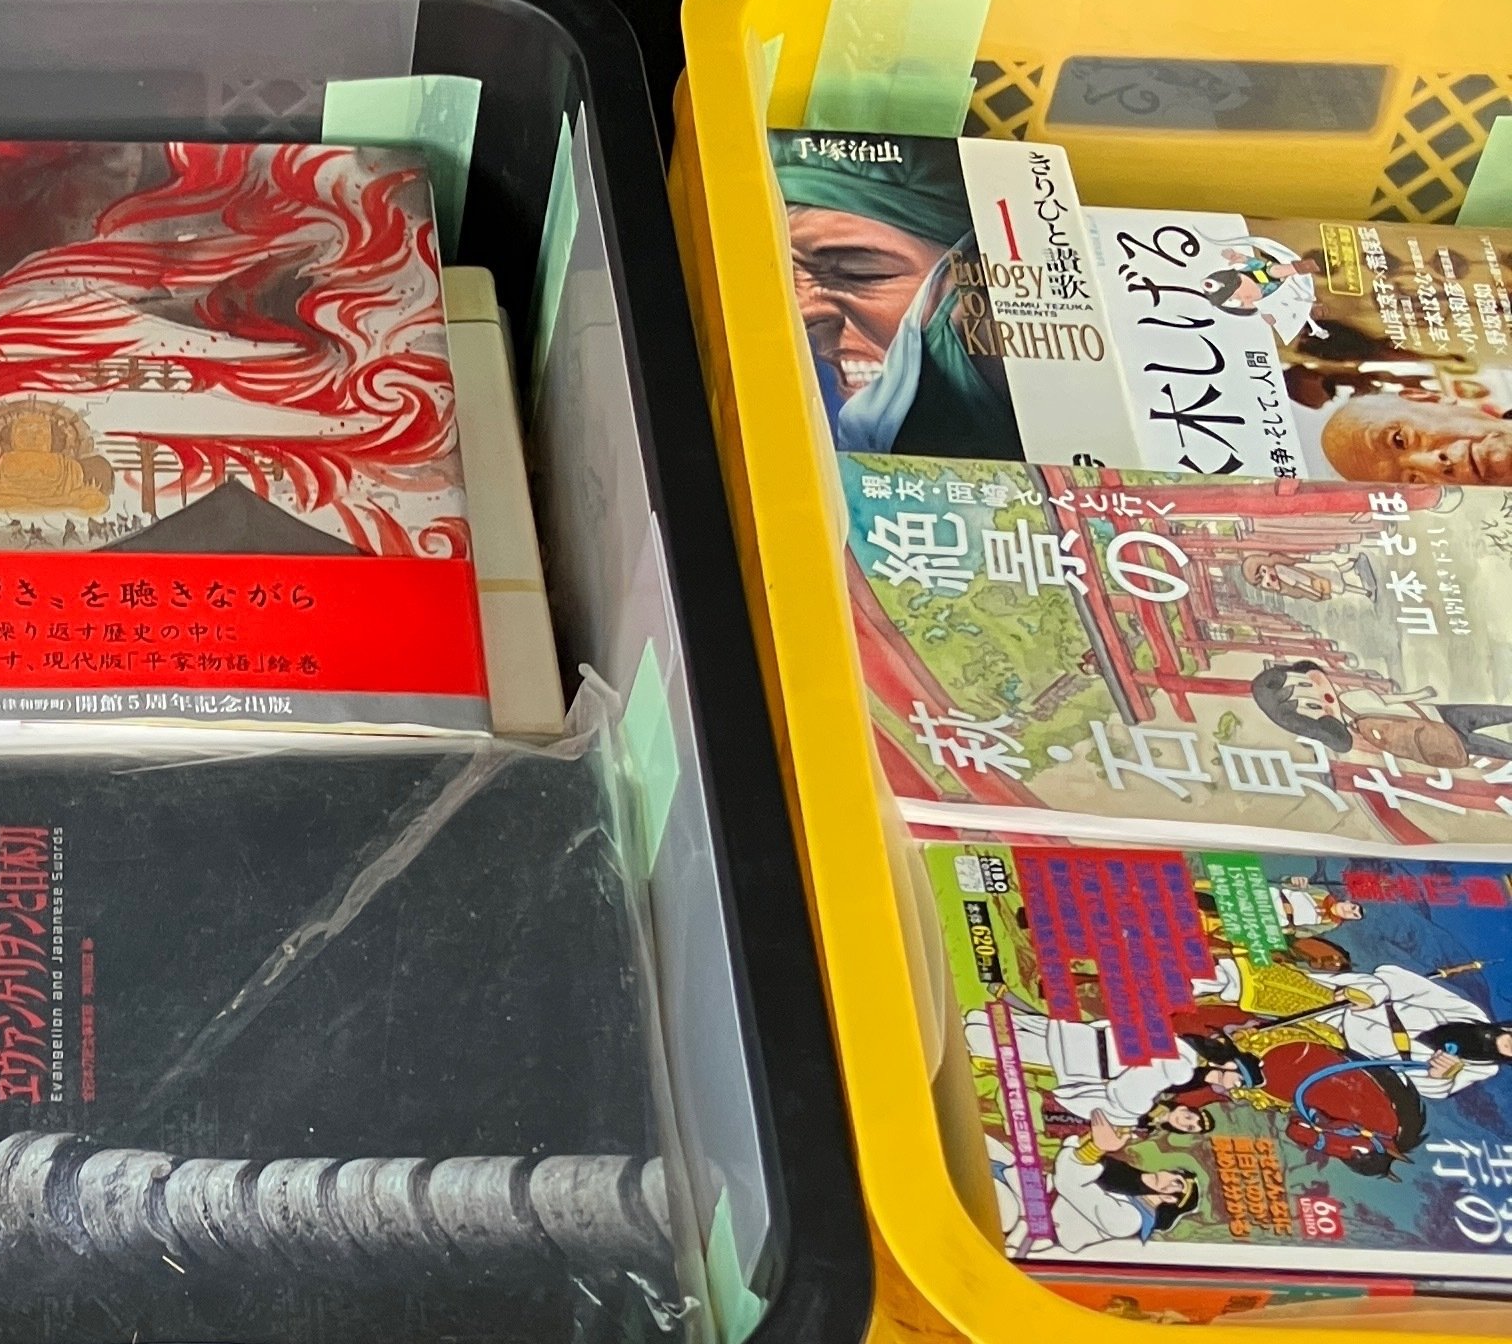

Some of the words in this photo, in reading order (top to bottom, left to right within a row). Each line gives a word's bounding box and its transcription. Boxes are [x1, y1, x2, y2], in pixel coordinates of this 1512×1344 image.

[795, 137, 903, 164] 手塚治虫
[947, 250, 1044, 299] Eulogy
[958, 288, 987, 319] to
[994, 300, 1040, 310] OSAMU
[1044, 302, 1093, 312] TEZUKA
[996, 308, 1058, 318] PRESENTS
[960, 319, 1106, 362] KIRIHITO
[865, 509, 1190, 604] 絶景の
[1368, 490, 1440, 638] 山本さほ
[51, 826, 64, 881] Swords
[988, 857, 1008, 893] KIBO
[51, 887, 64, 963] Japanese
[52, 969, 64, 1001] and
[50, 1007, 64, 1103] Evangelion
[1299, 1197, 1317, 1237] USHIO
[1312, 1200, 1337, 1235] 60
